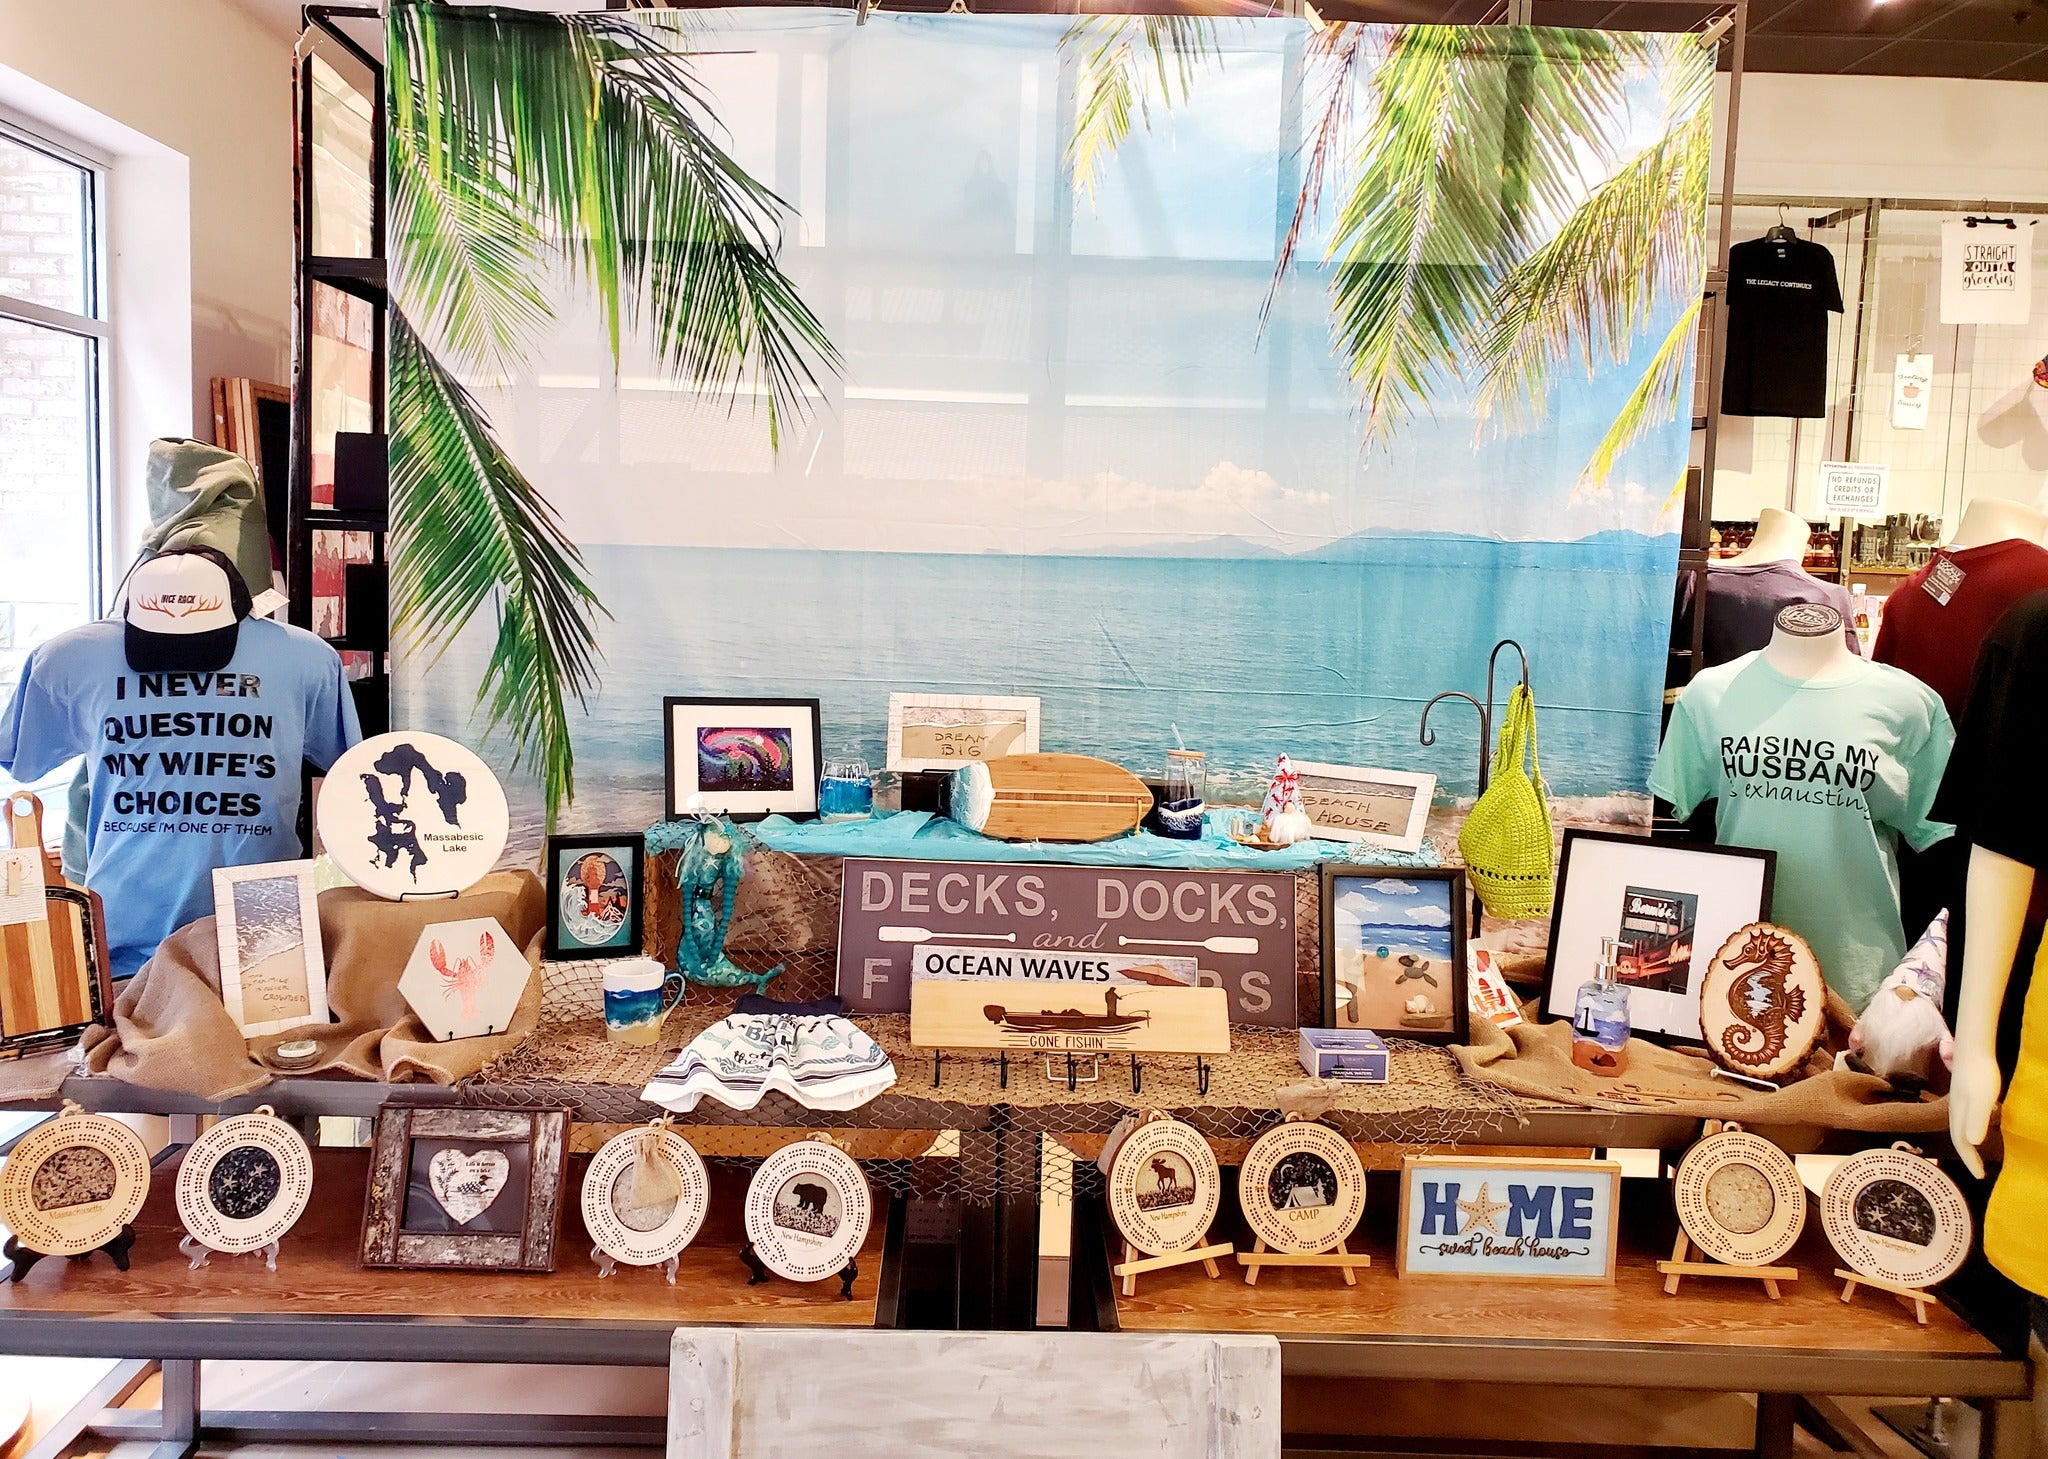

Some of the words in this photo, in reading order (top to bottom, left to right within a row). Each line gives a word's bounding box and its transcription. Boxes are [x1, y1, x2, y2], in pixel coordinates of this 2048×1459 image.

[1966, 245, 2015, 261] STRAIGHT
[1972, 261, 2008, 272] OUTTA
[1780, 281, 1812, 290] CONTINUES
[1964, 273, 2013, 289] groceries
[1845, 477, 1877, 485] REFUNDS
[1834, 485, 1862, 493] CREDITS
[1864, 486, 1875, 494] OR
[1832, 494, 1874, 503] EXCHANGES
[161, 594, 177, 604] NICE
[177, 594, 197, 604] RACK
[116, 676, 126, 700] I
[139, 672, 261, 699] NEVER
[104, 712, 273, 744] QUESTION
[935, 732, 988, 743] DREAM
[941, 743, 981, 757] BIG
[1721, 736, 1835, 760] RAISING
[1845, 745, 1879, 771] MY
[102, 752, 150, 778] MY
[158, 751, 276, 779] WIFE'S
[1722, 755, 1876, 792] HUSBAND
[113, 790, 262, 817] CHOICES
[1302, 796, 1371, 814] BEACH
[103, 821, 156, 833] BECAUSE
[158, 822, 175, 833] I'M
[178, 821, 208, 834] ONE
[211, 822, 233, 833] OF
[235, 824, 272, 836] THEM
[1316, 809, 1390, 832] HOUSE
[424, 833, 484, 841] Massabesic
[442, 844, 467, 852] Lake
[861, 871, 1058, 922] DECKS,
[1097, 878, 1287, 930] DOCKS,
[1032, 922, 1108, 950] and
[925, 953, 1012, 977] OCEAN
[1020, 957, 1110, 982] WAVES
[263, 994, 306, 1003] CROWDED
[1030, 1035, 1061, 1048] GONE
[1065, 1036, 1106, 1048] FISHIN'
[1289, 1209, 1320, 1221] CAMP
[1420, 1182, 1593, 1239] HME
[1438, 1232, 1483, 1257] sweet
[1482, 1236, 1524, 1257] beach
[1525, 1236, 1570, 1259] house
